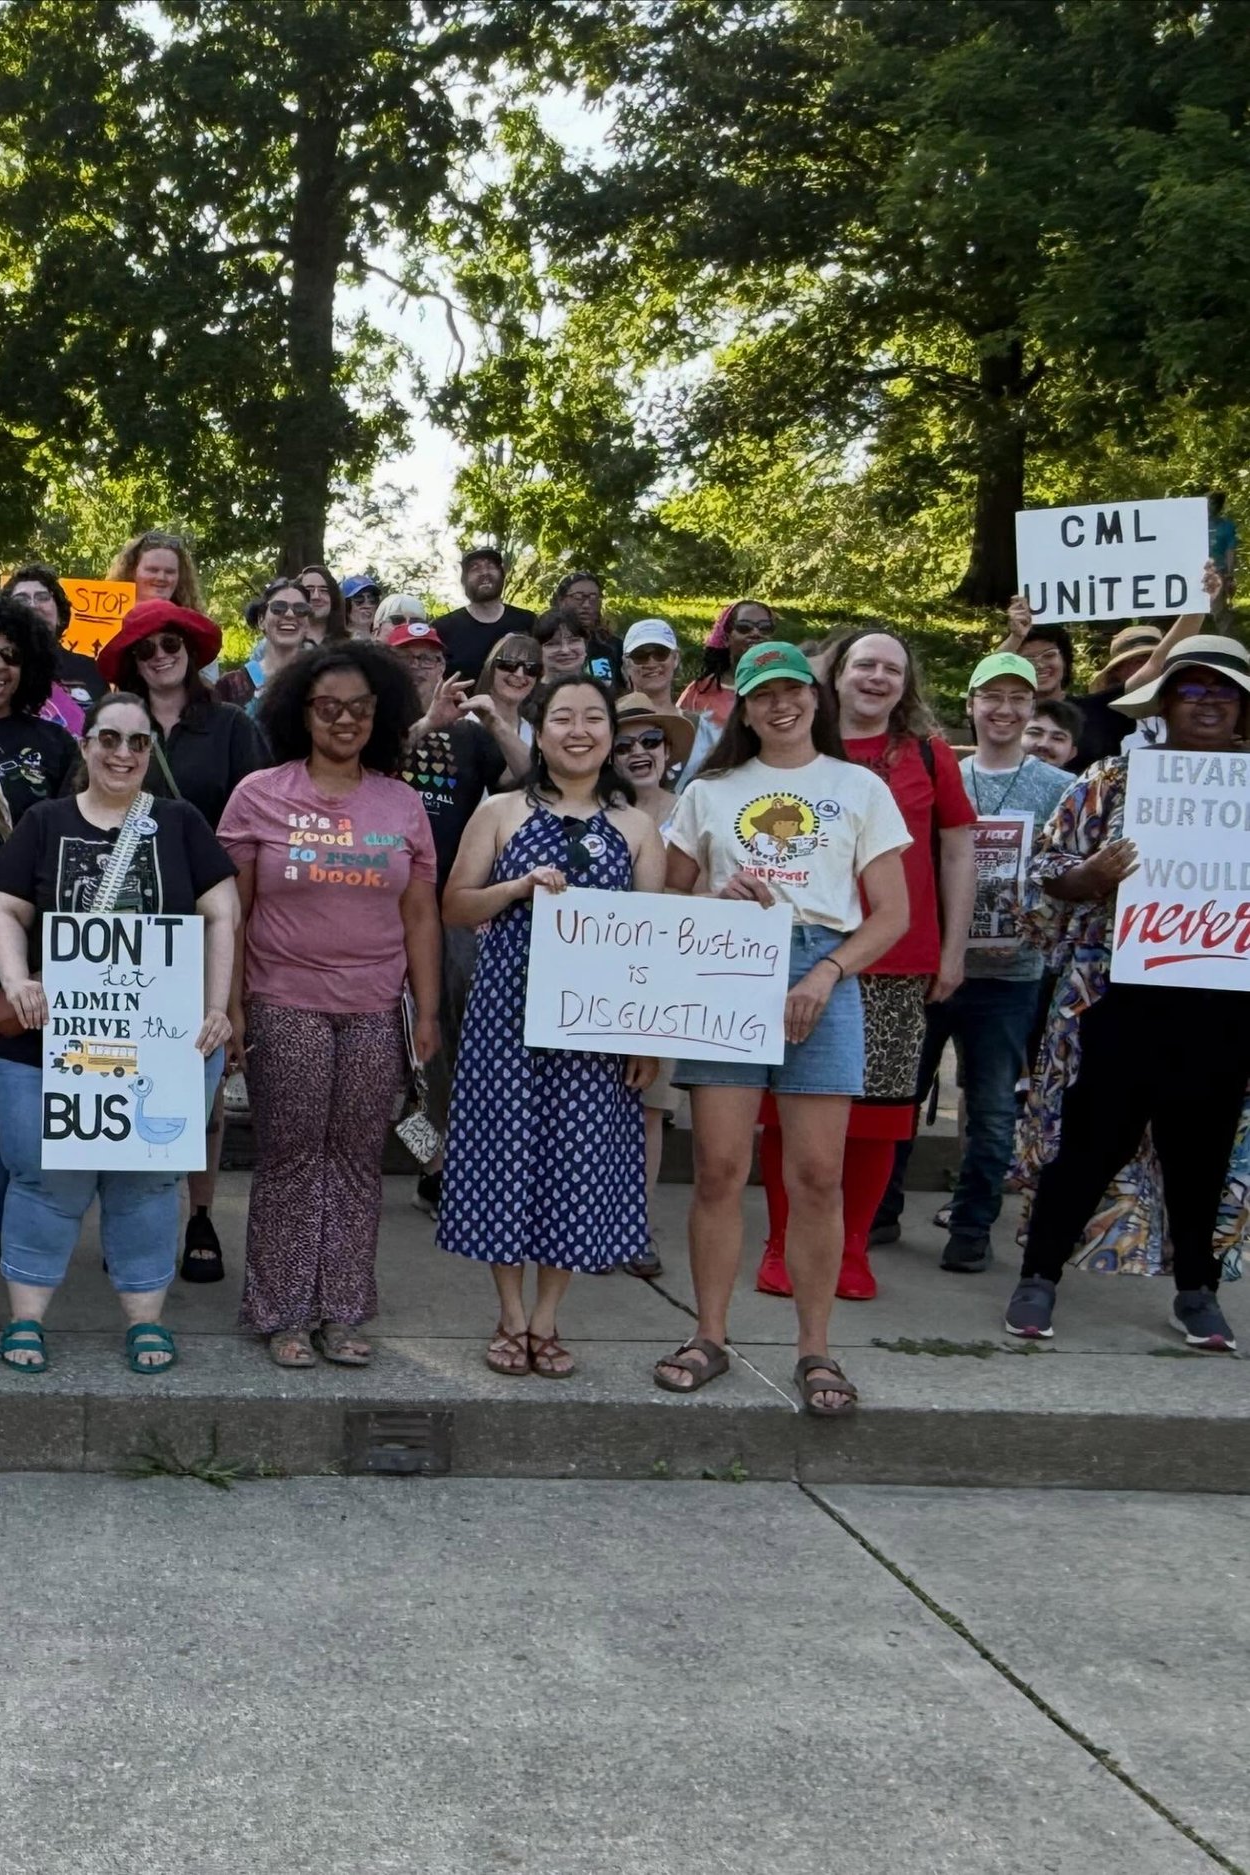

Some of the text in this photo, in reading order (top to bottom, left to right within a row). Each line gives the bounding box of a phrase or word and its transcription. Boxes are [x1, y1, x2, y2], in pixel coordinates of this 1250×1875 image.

[1061, 509, 1157, 548] CML
[72, 588, 129, 614] STOP
[1157, 754, 1247, 788] LEVAR
[288, 813, 352, 830] it's a
[1136, 796, 1250, 832] BURTO
[288, 831, 354, 846] good
[289, 847, 388, 869] to read
[284, 865, 298, 880] a
[50, 915, 184, 966] DON'T
[629, 965, 649, 984] is
[53, 990, 141, 1012] ADMIN
[53, 1016, 189, 1040] DRIVE the
[558, 991, 767, 1047] DISGUSTING
[43, 1092, 132, 1142] BUS
